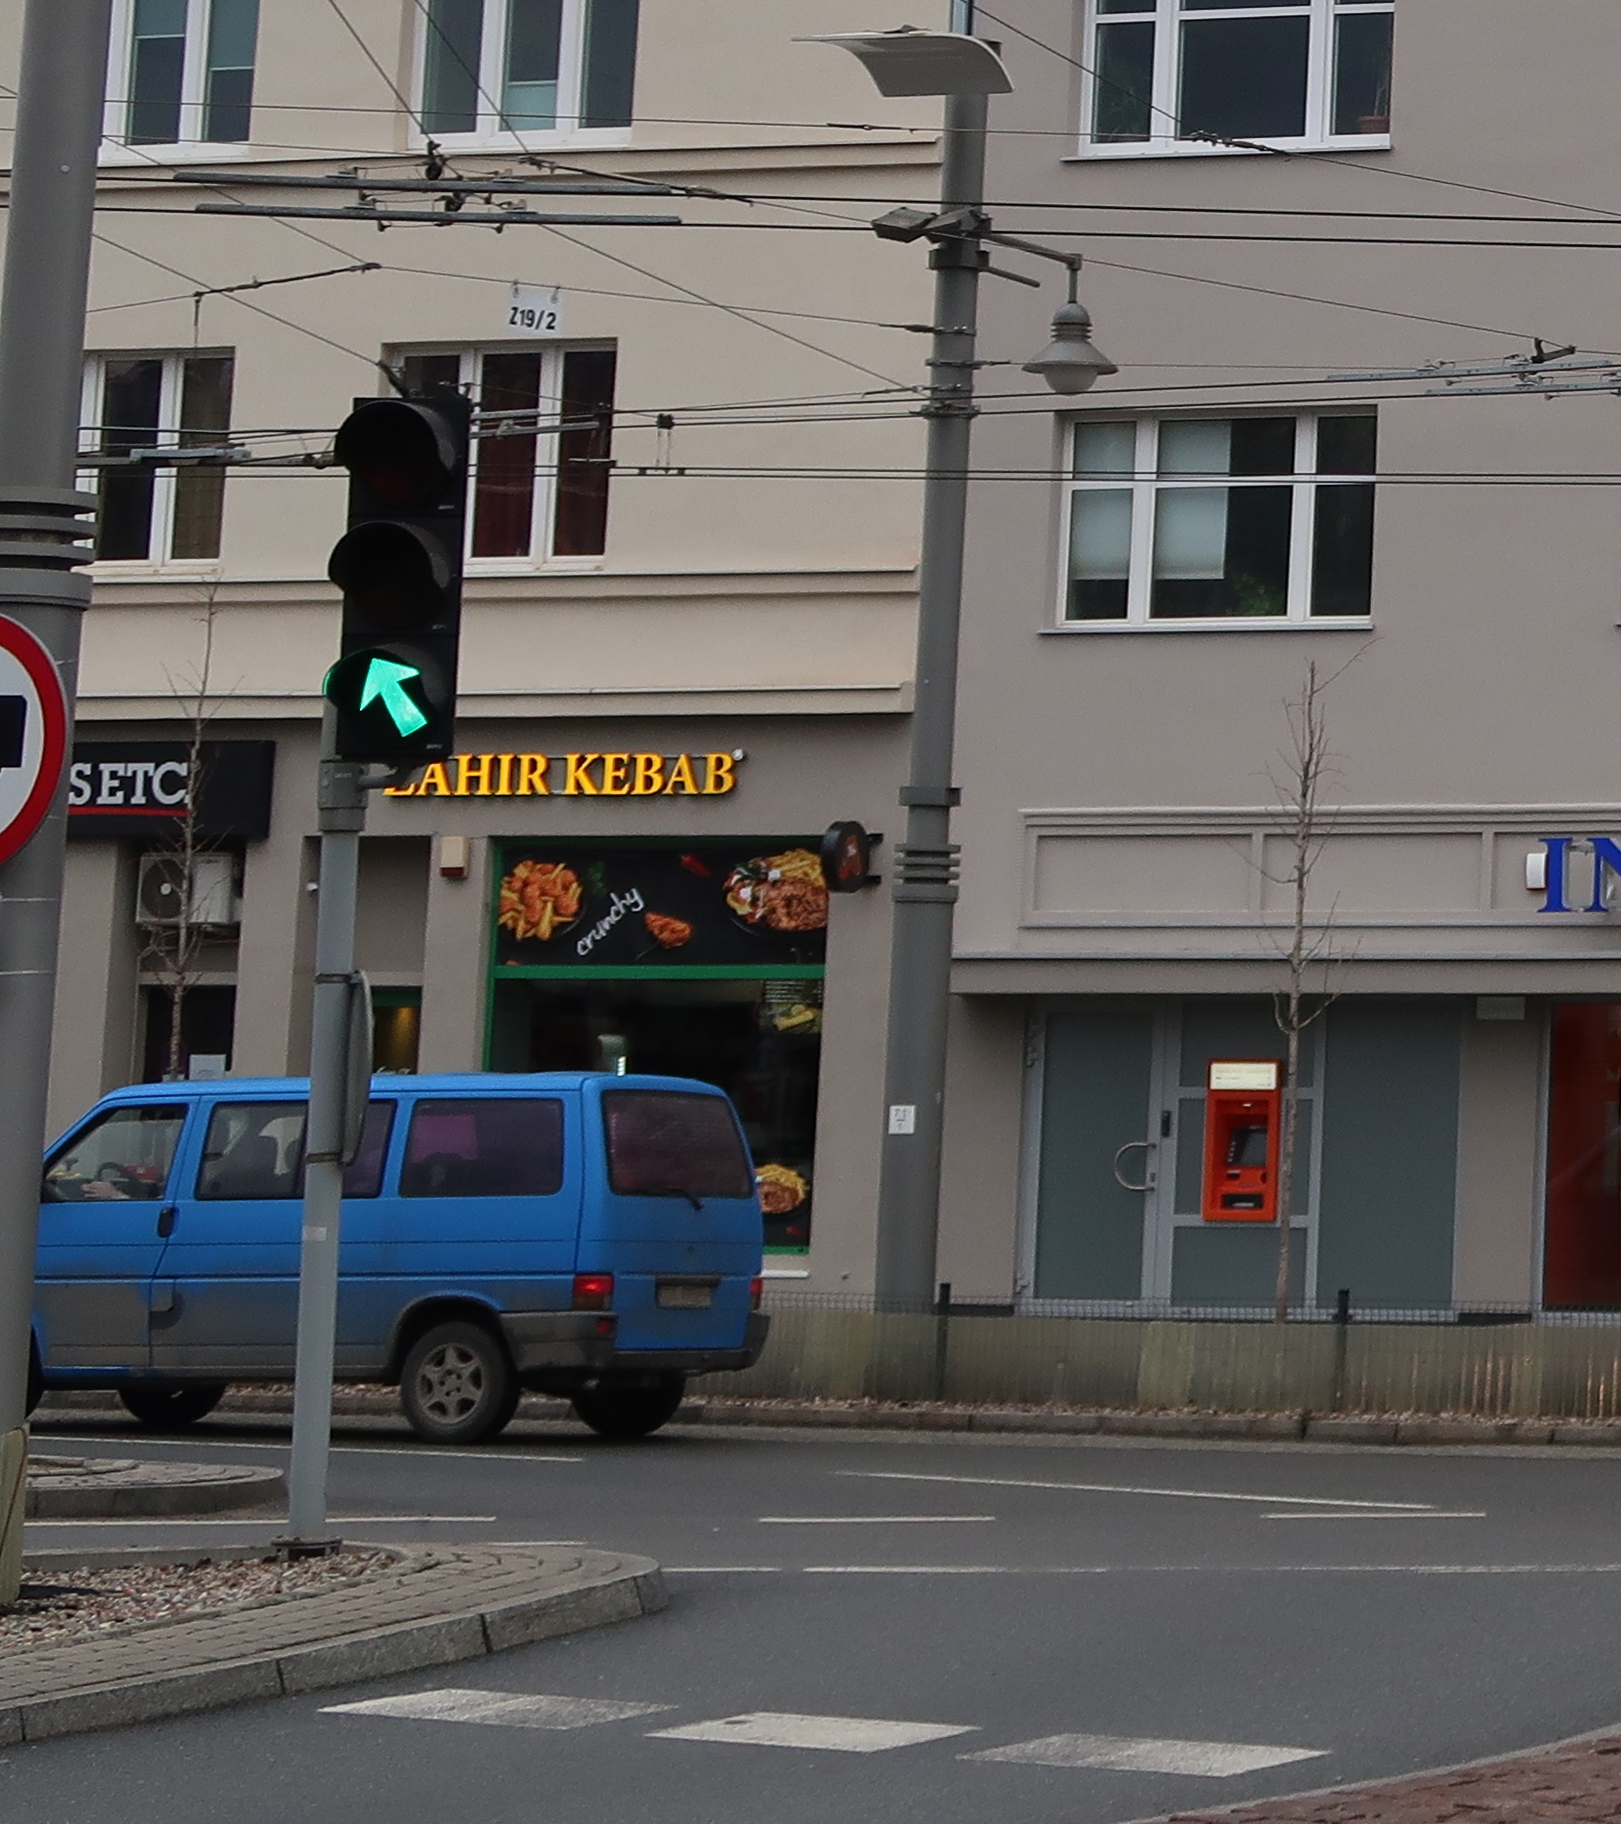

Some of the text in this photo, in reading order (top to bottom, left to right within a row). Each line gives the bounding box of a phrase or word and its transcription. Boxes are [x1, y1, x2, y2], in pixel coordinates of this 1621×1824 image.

[509, 306, 557, 331] Z19/2
[561, 752, 736, 796] KEBAB
[575, 886, 645, 957] crunchy
